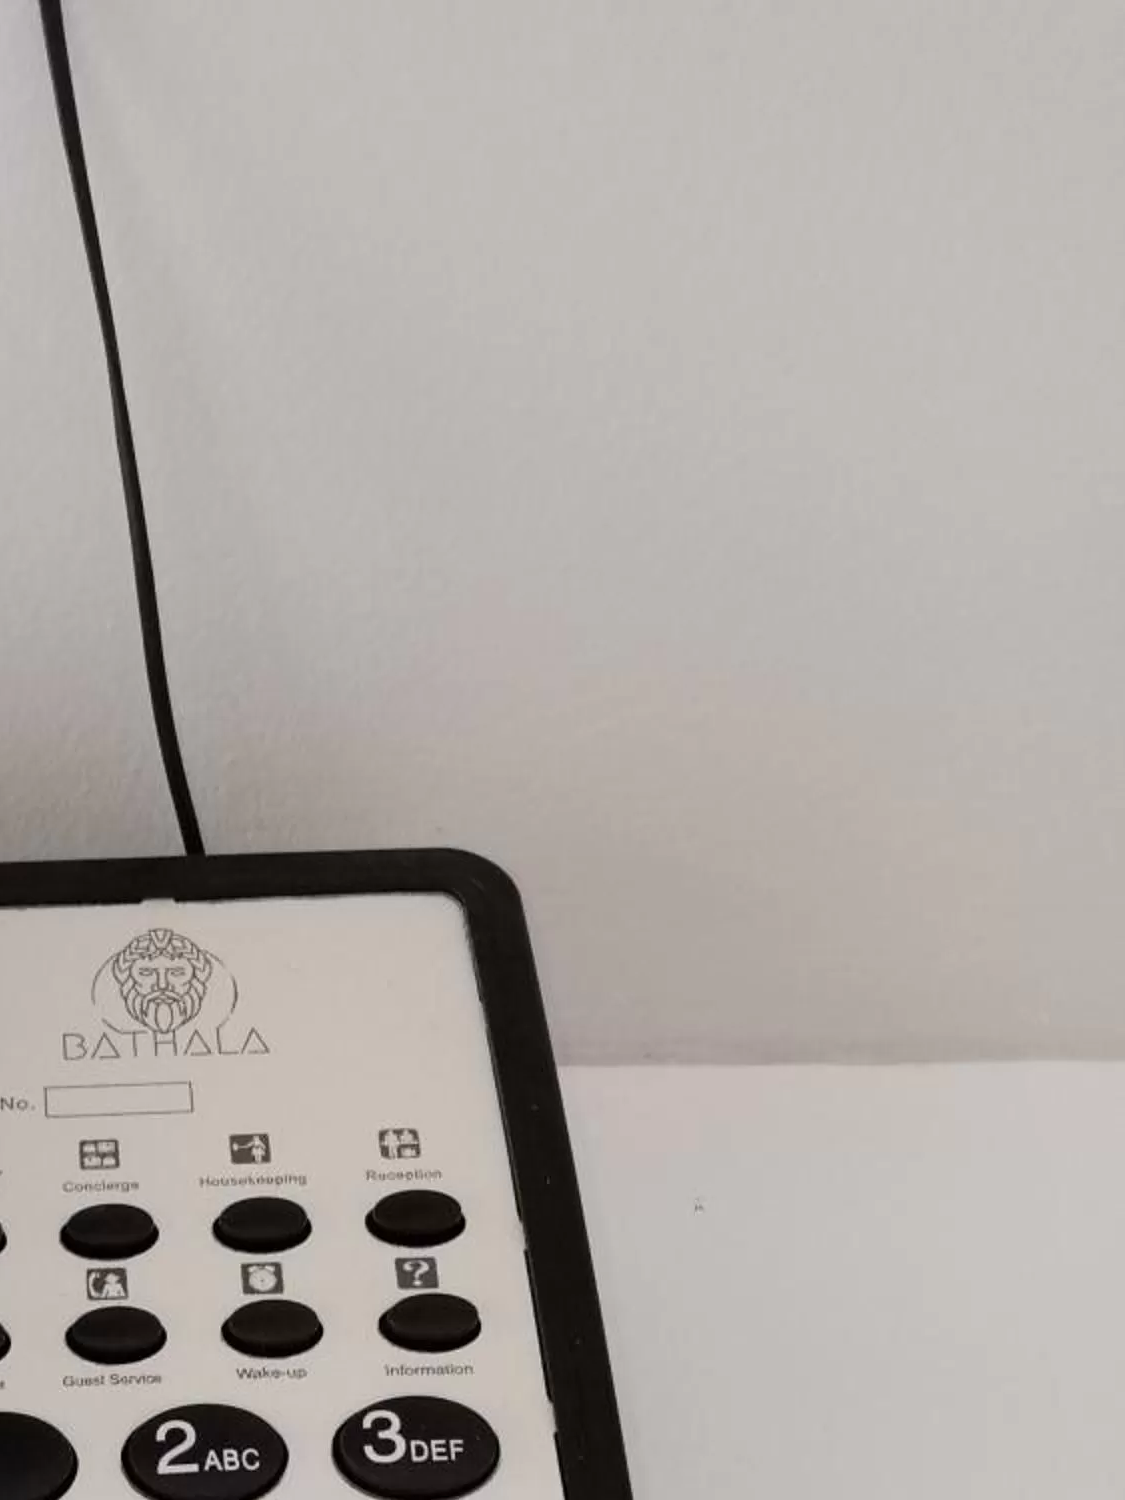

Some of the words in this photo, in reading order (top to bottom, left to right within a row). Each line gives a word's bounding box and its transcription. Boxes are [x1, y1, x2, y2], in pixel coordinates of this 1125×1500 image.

[61, 1026, 271, 1061] BATHALA
[198, 1173, 308, 1189] Housekeeping
[364, 1168, 443, 1182] Reception
[61, 1179, 140, 1194] Concierge
[235, 1366, 308, 1383] Wake-up
[383, 1362, 475, 1378] Information
[61, 1374, 107, 1389] Guest
[108, 1373, 163, 1387] Service
[361, 1410, 406, 1463] 3
[409, 1439, 464, 1463] DEF
[155, 1419, 200, 1475] 2
[203, 1447, 260, 1472] ABC
